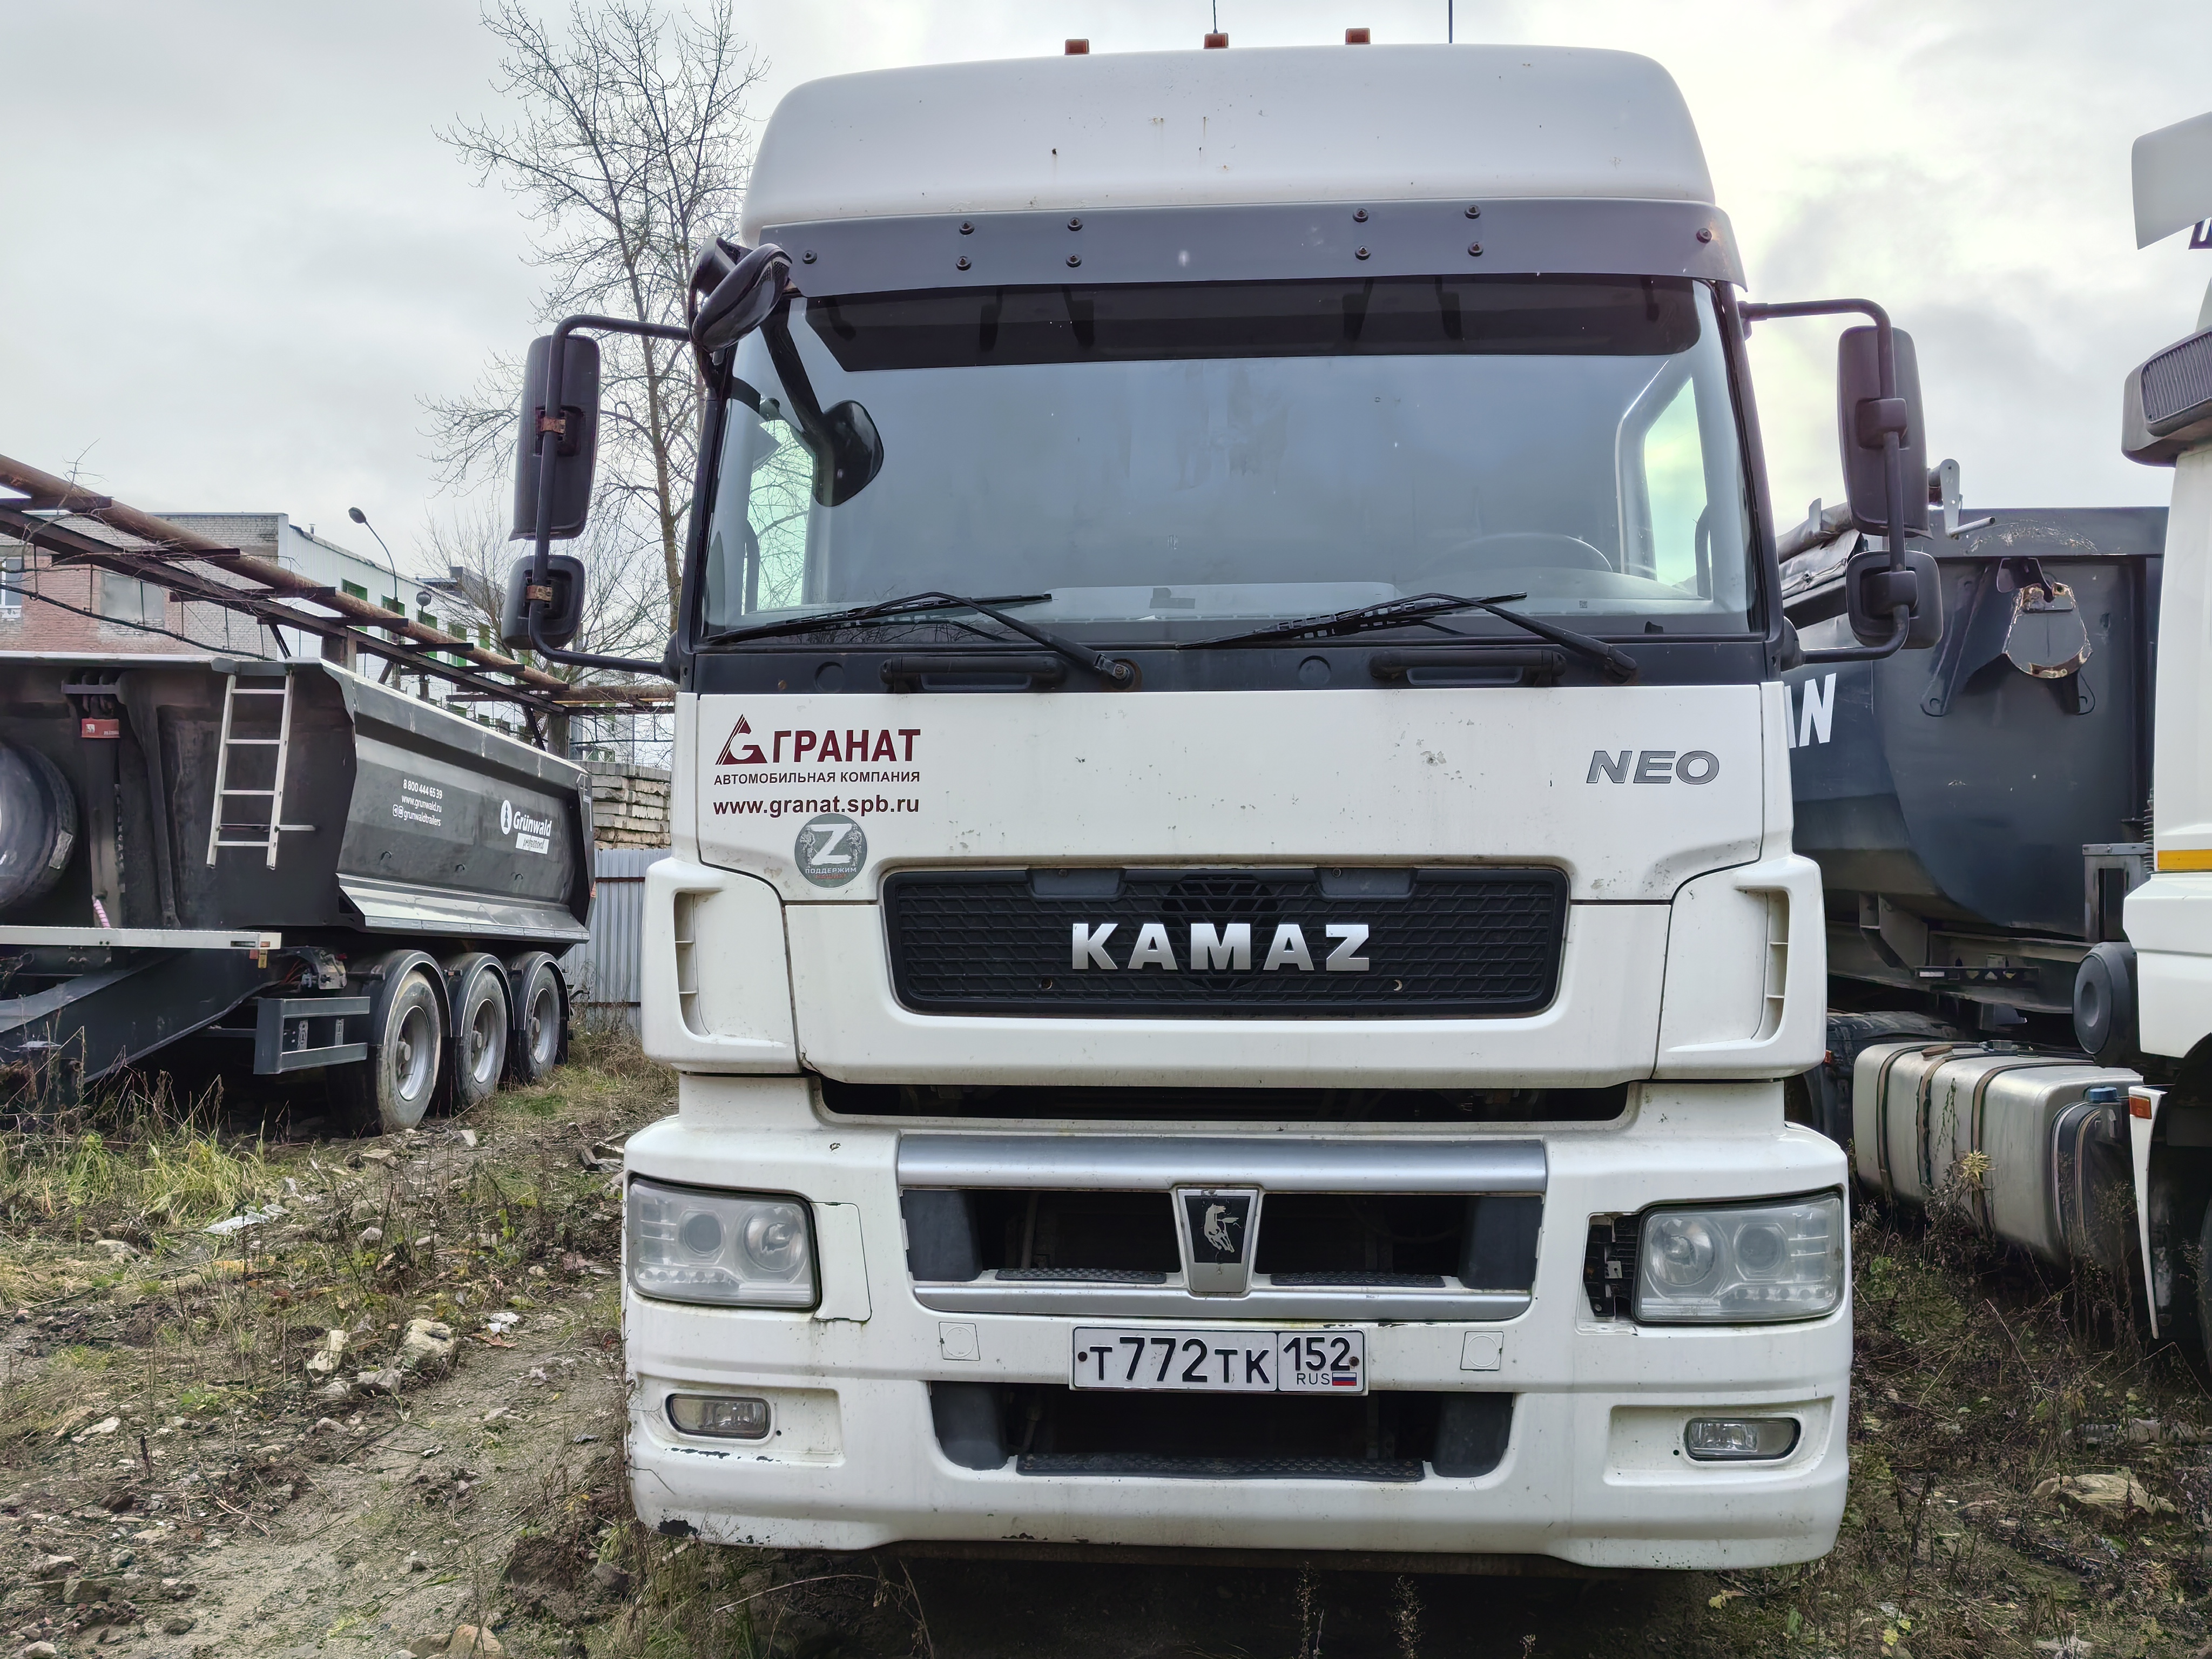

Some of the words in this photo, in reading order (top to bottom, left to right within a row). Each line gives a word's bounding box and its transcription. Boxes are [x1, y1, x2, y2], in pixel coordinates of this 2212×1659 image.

[772, 729, 921, 763] ГРАНАТ
[713, 772, 835, 785] АВТОМОБИЛЬНАЯ
[840, 771, 920, 783] КОМПАНИЯ
[1586, 750, 1719, 785] NEO
[403, 779, 407, 789] 8
[408, 780, 419, 792] 800
[419, 784, 429, 795] 444
[429, 787, 436, 798] 65
[436, 788, 442, 799] 39
[401, 795, 442, 813] www.grunwald.ru
[713, 794, 919, 818] www.granat.spb.ru
[403, 811, 441, 826] grunwaldtrailers
[513, 811, 552, 837] Grünwald
[808, 823, 852, 866] Z
[1072, 923, 1370, 971] KAMAZ
[1283, 1337, 1351, 1371] 152
[1297, 1373, 1330, 1385] RUS
